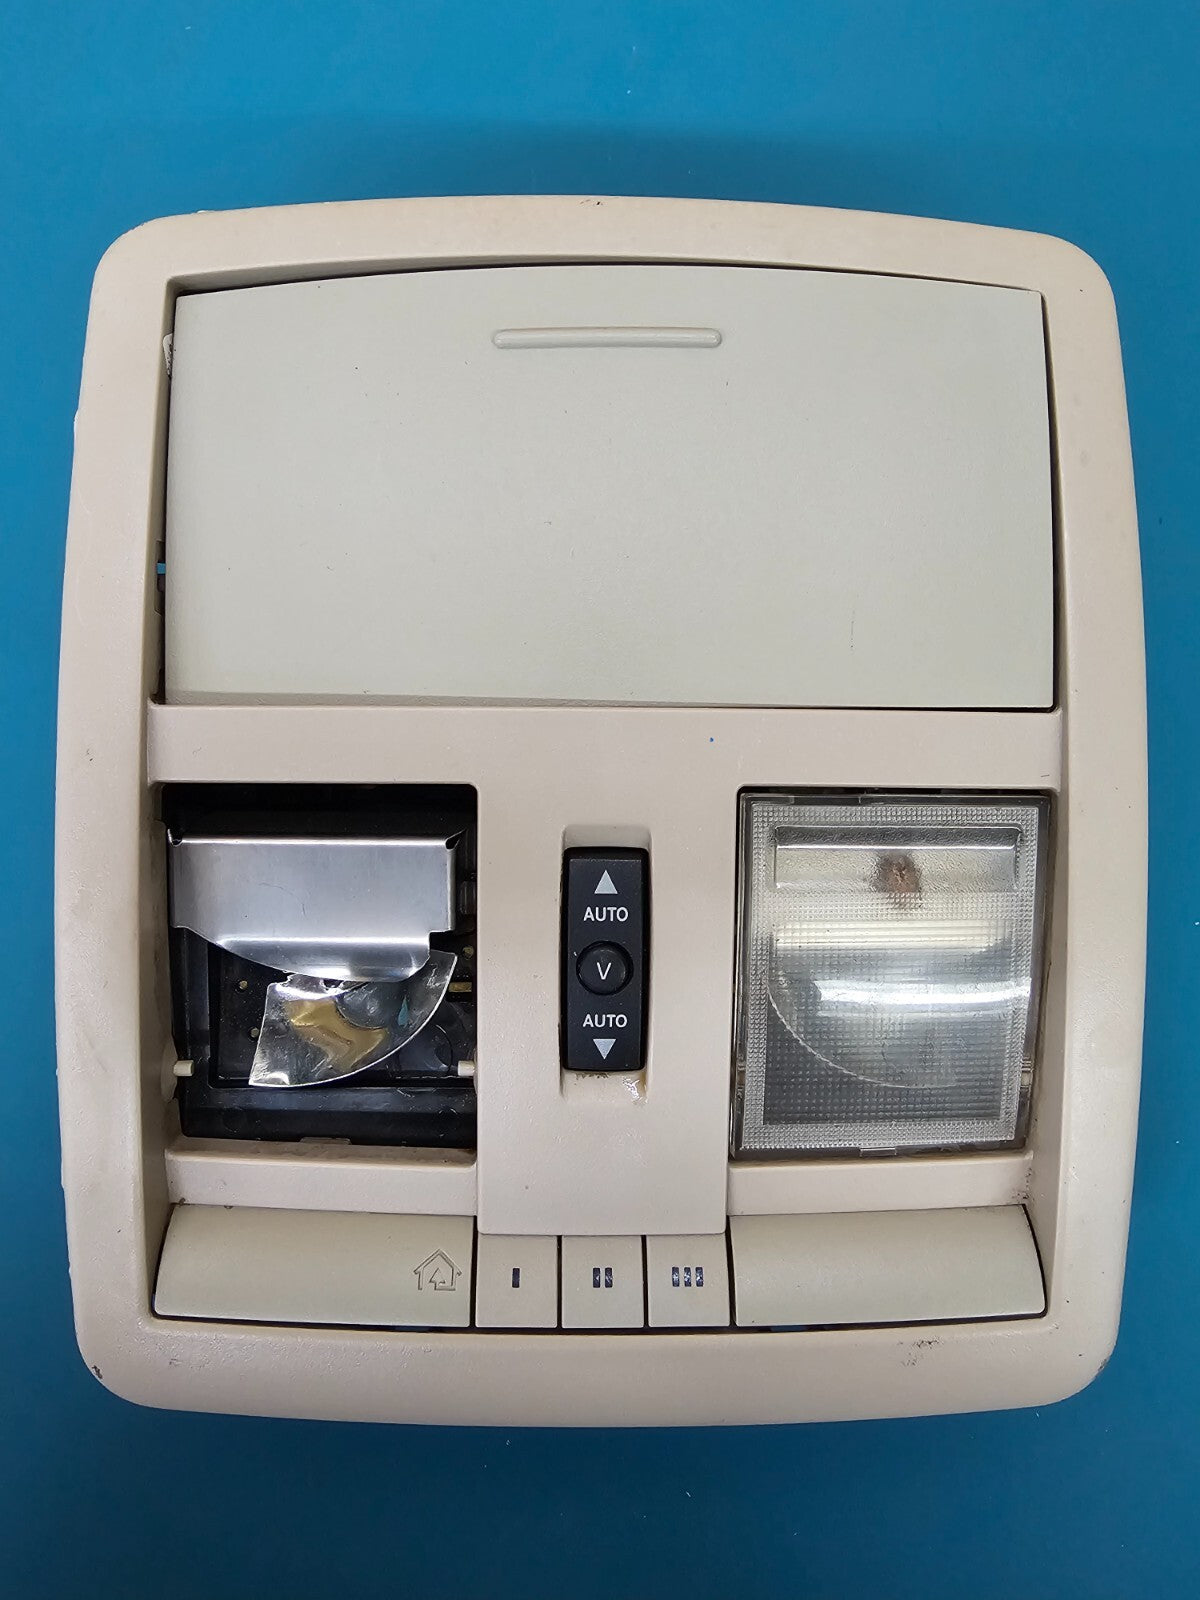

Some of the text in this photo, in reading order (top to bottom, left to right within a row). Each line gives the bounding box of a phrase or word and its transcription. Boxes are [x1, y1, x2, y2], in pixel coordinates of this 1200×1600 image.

[583, 906, 629, 922] AUTO
[596, 962, 612, 980] V
[582, 1013, 628, 1028] AUTO
